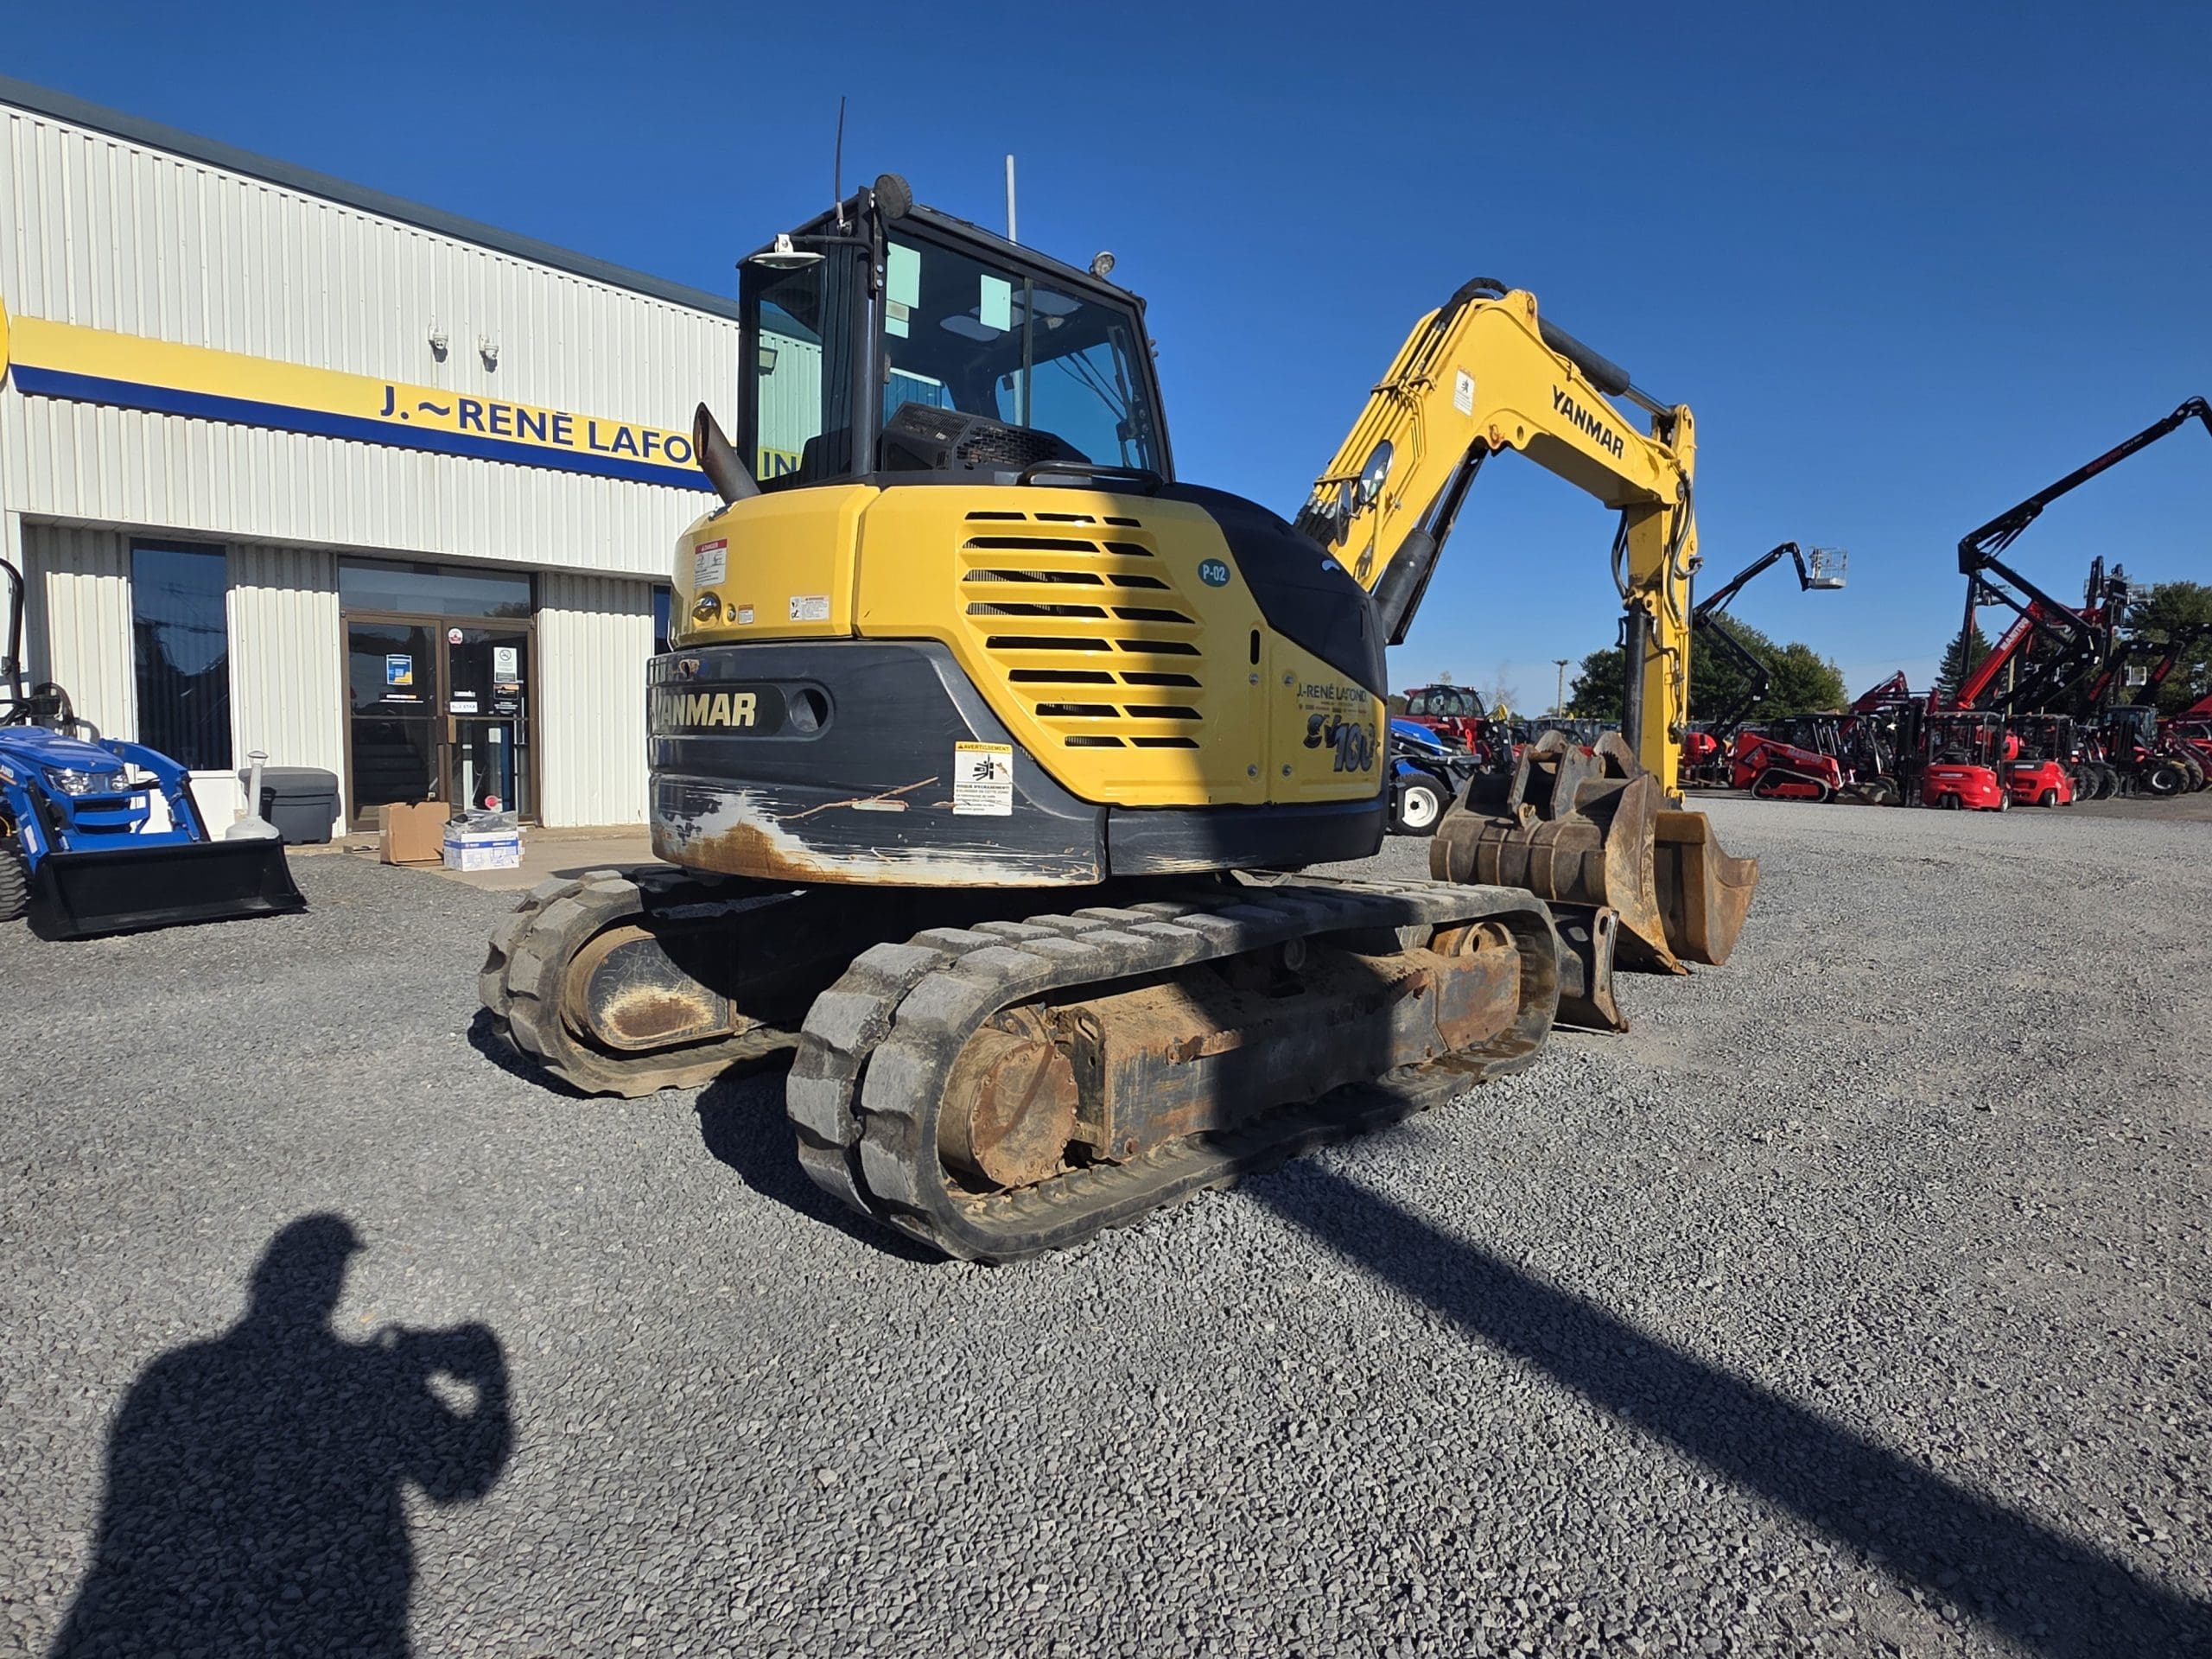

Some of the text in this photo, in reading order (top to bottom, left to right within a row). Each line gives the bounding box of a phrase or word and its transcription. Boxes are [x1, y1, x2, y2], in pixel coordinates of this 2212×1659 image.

[588, 420, 692, 464] LAFO
[763, 451, 797, 478] IN
[1553, 384, 1624, 460] YANMAR
[1203, 564, 1226, 582] P-02
